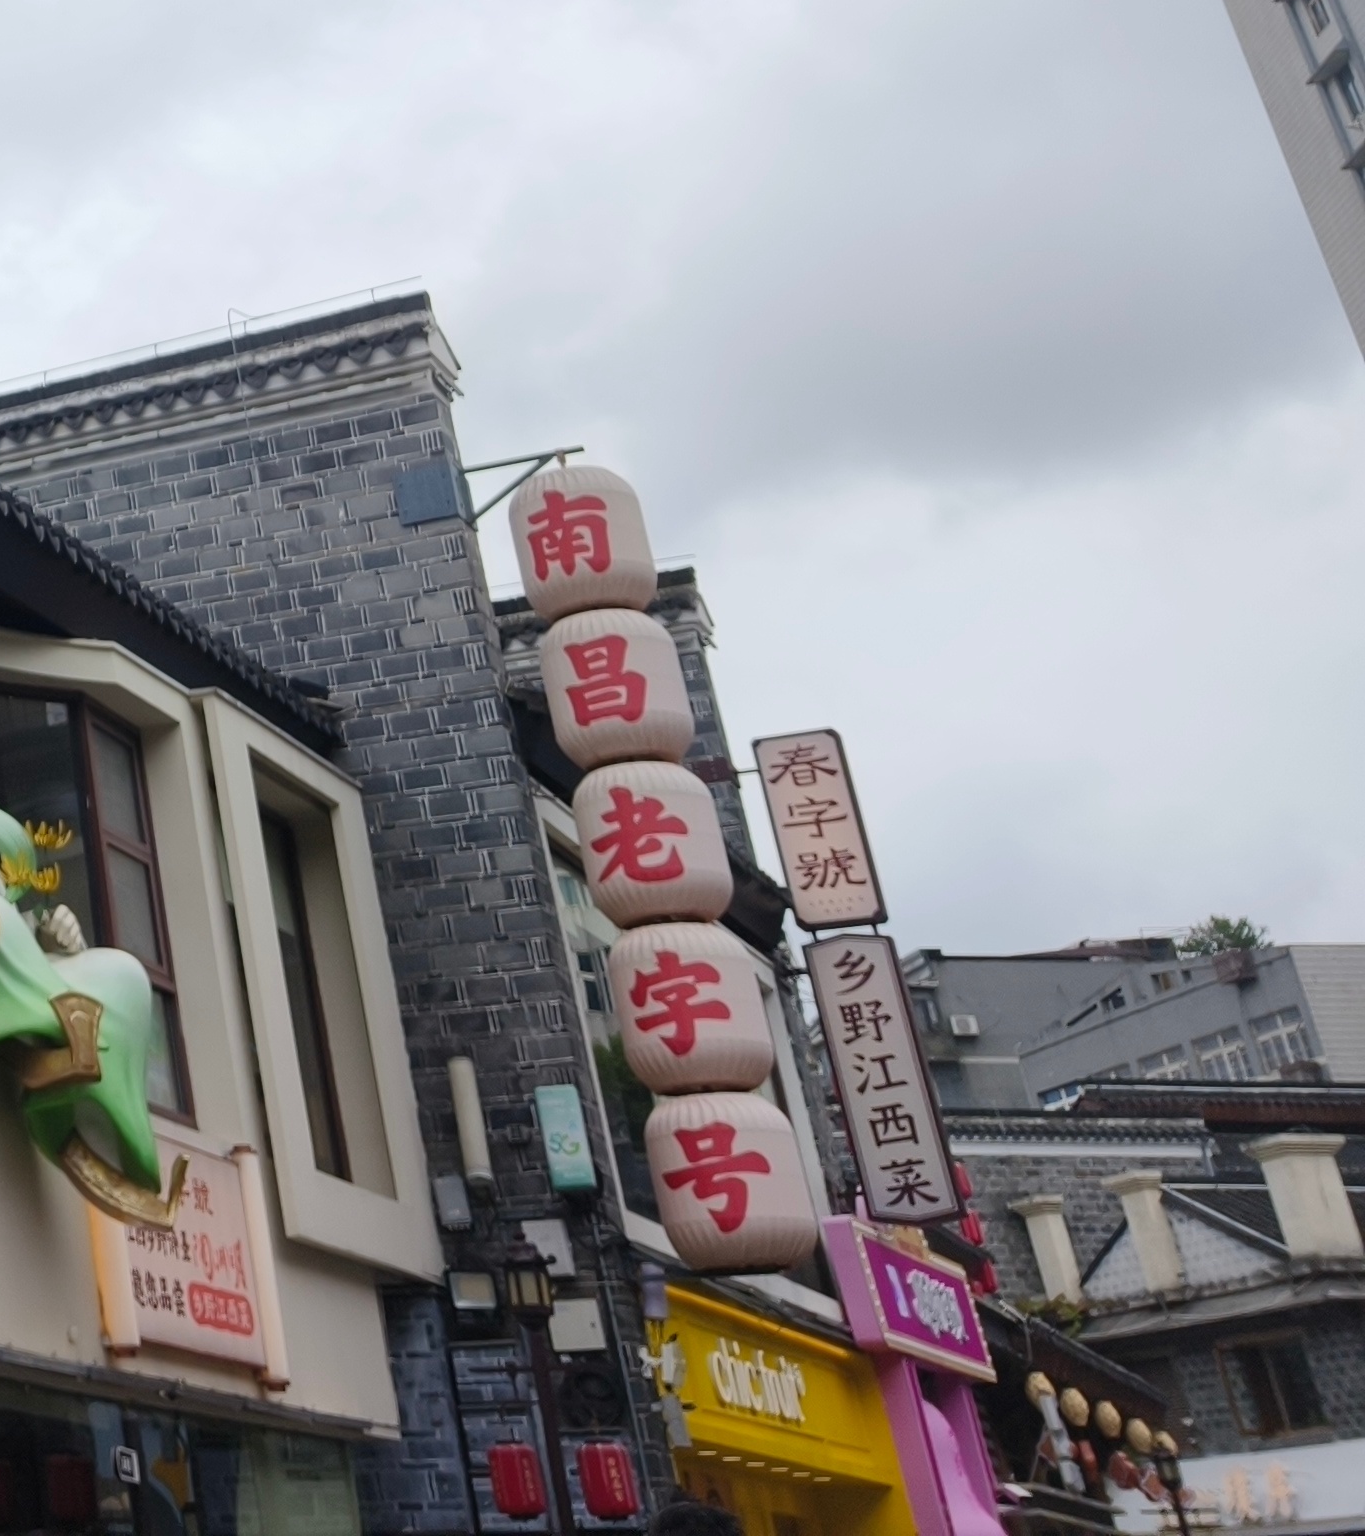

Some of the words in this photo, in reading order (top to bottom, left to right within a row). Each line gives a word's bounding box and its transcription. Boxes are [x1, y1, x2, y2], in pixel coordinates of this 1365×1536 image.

[527, 490, 771, 1233] 南昌老字号
[768, 743, 867, 891] 春字號
[833, 949, 940, 1207] 乡野江西菜
